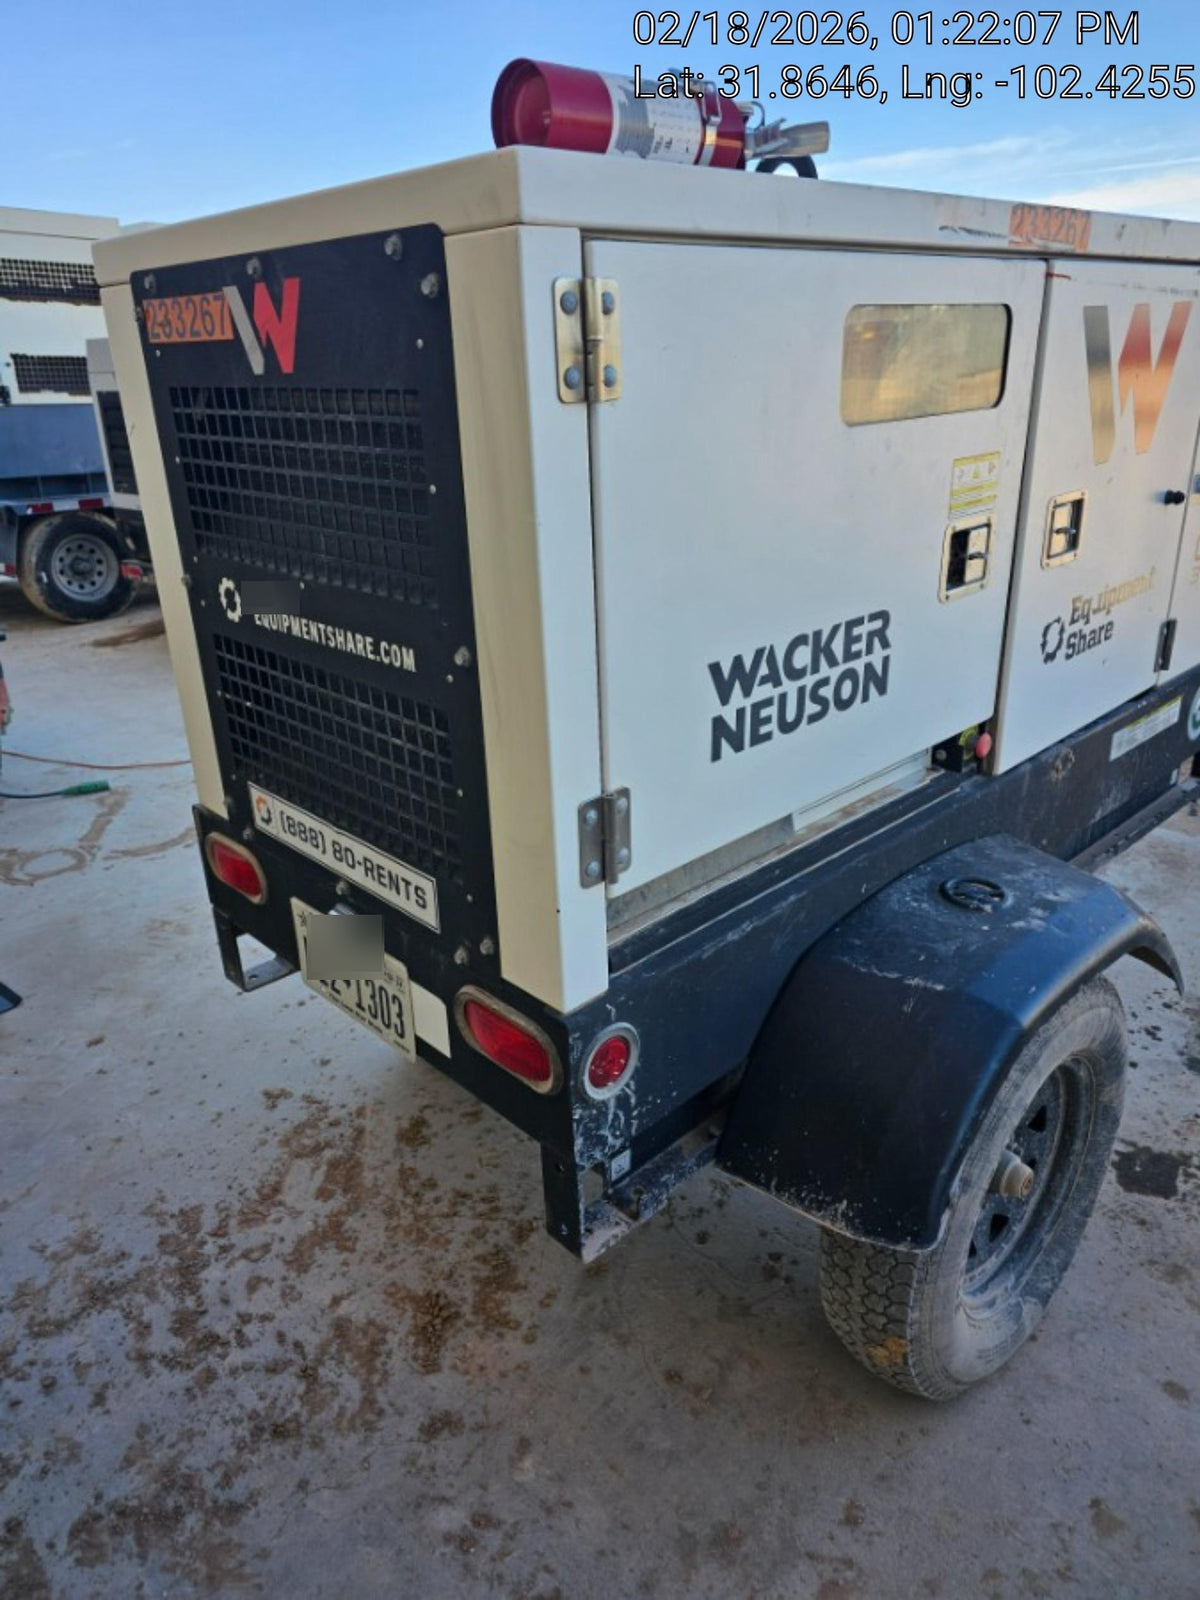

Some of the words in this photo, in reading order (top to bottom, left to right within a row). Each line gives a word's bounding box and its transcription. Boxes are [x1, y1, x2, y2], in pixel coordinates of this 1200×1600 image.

[144, 292, 227, 340] 233267
[708, 609, 892, 707] WACKER
[1065, 619, 1115, 661] Share
[711, 654, 891, 763] NEUSON
[279, 810, 327, 855] (888)
[331, 840, 428, 909] 80-RENTS
